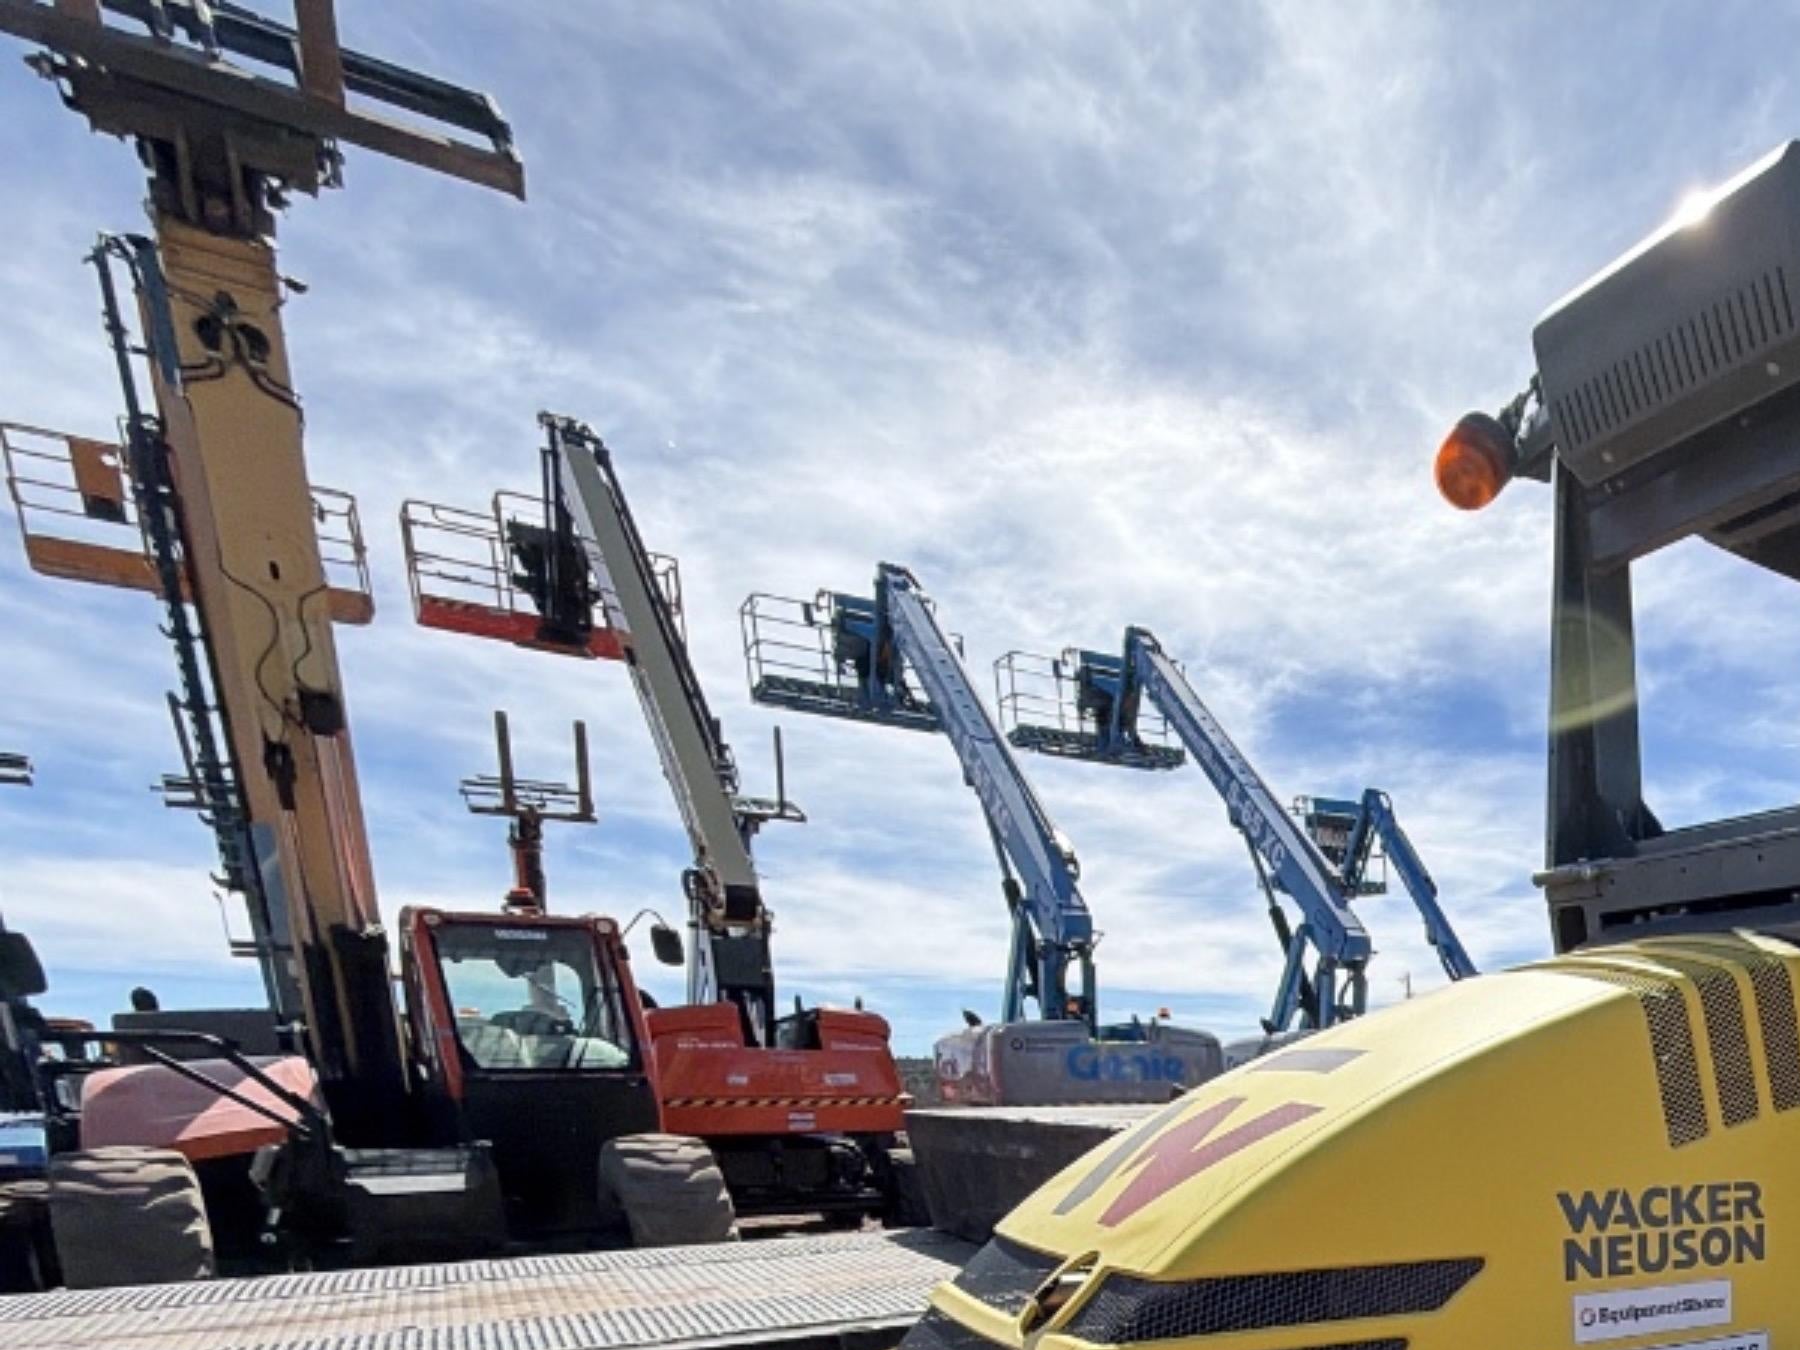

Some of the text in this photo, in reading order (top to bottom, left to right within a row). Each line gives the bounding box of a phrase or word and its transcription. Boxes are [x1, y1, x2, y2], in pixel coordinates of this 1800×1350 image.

[1066, 1044, 1185, 1082] Genie
[1556, 1180, 1765, 1235] WACKER
[1564, 1223, 1766, 1282] NEUSON
